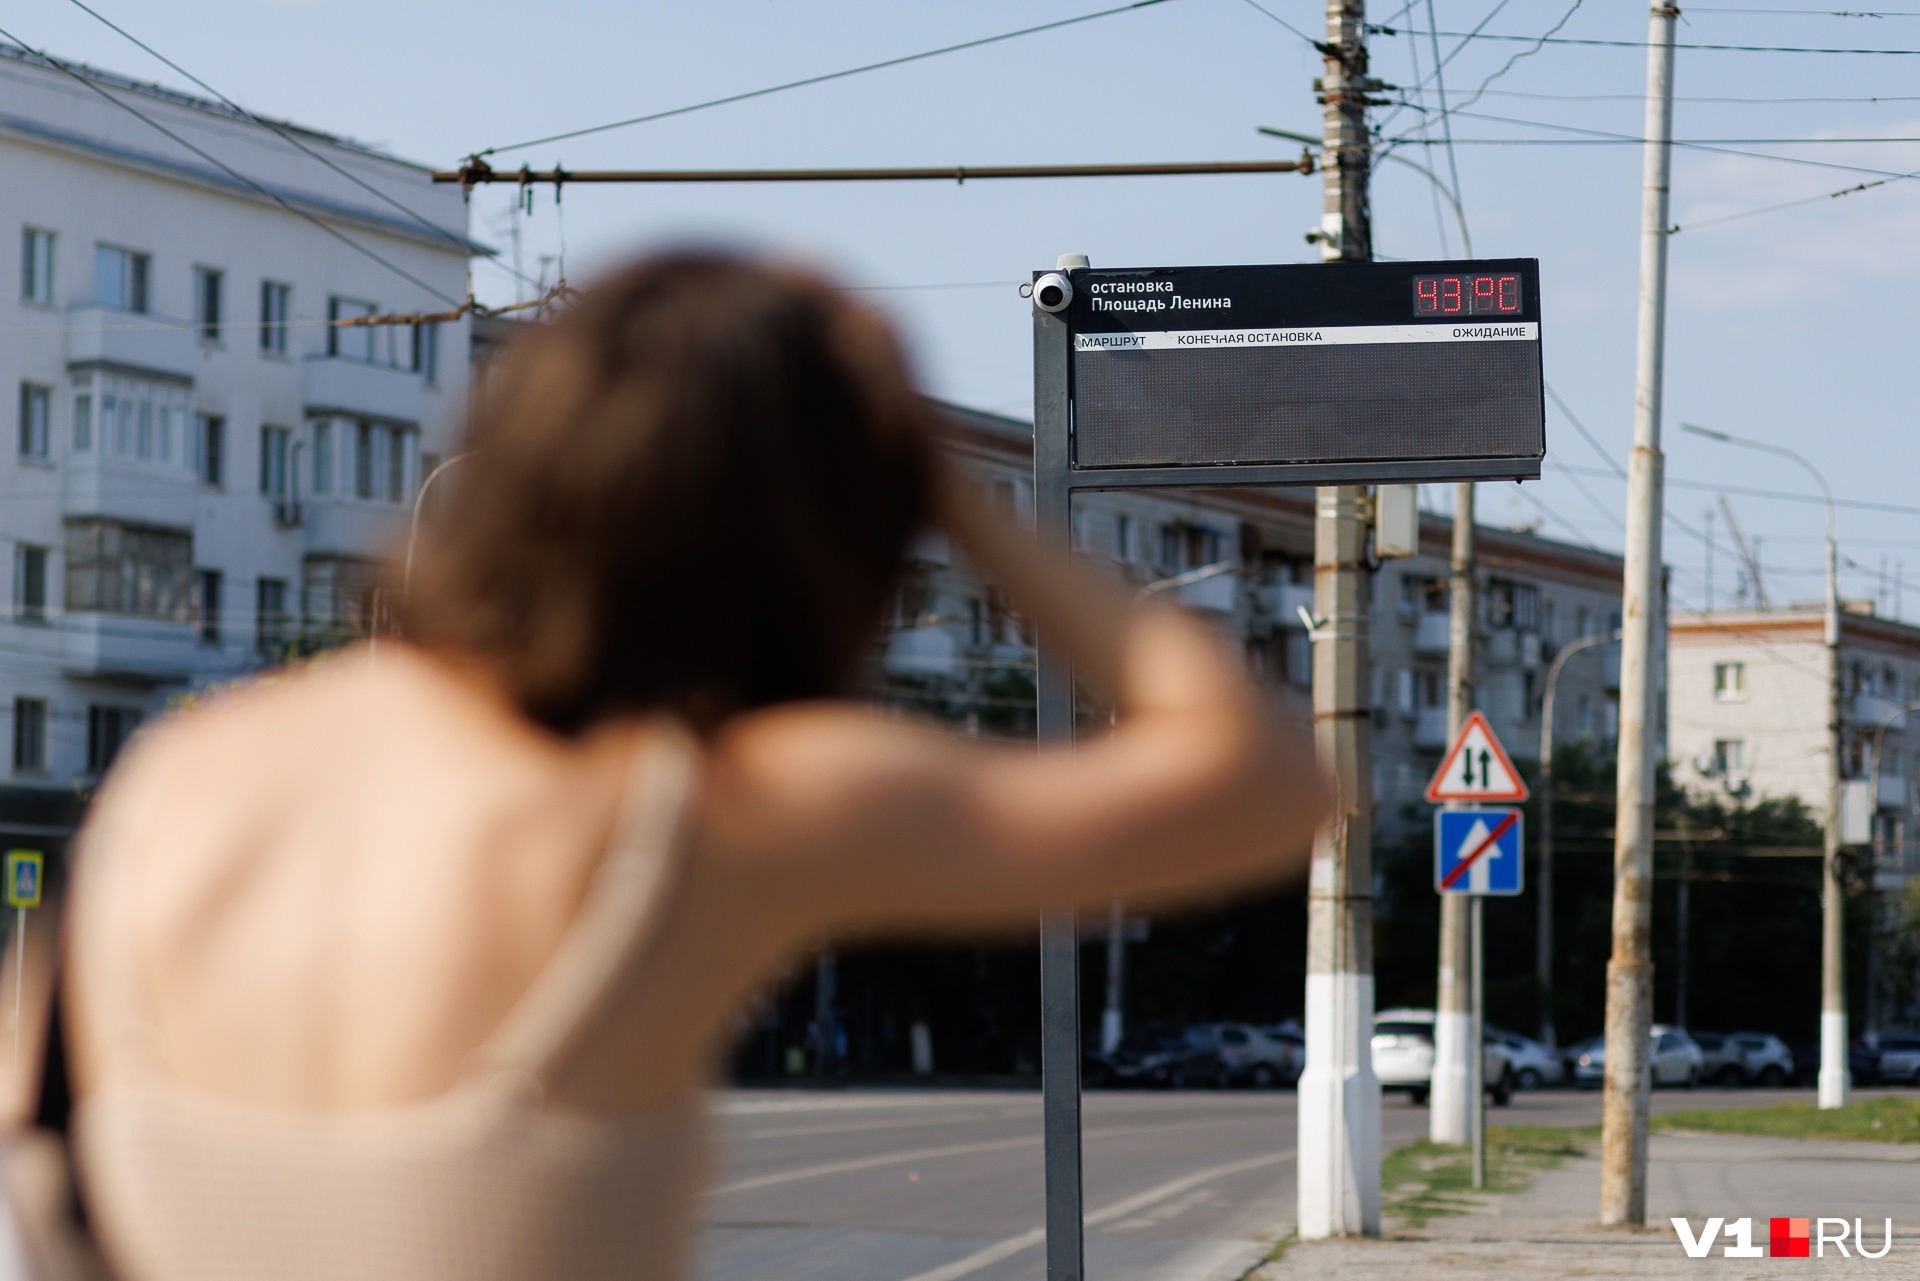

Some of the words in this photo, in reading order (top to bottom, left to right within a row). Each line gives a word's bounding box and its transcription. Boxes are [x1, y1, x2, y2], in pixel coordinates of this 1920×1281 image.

[1091, 281, 1174, 294] остановка
[1092, 297, 1166, 312] Площадь
[1170, 295, 1232, 309] Ленина
[1081, 336, 1146, 347] МАРШРУТ
[1177, 334, 1244, 345] КОНЕЧНАЯ
[1247, 332, 1322, 343] ОСТАНОВКА
[1453, 327, 1526, 339] ОЖИДАНИЕ
